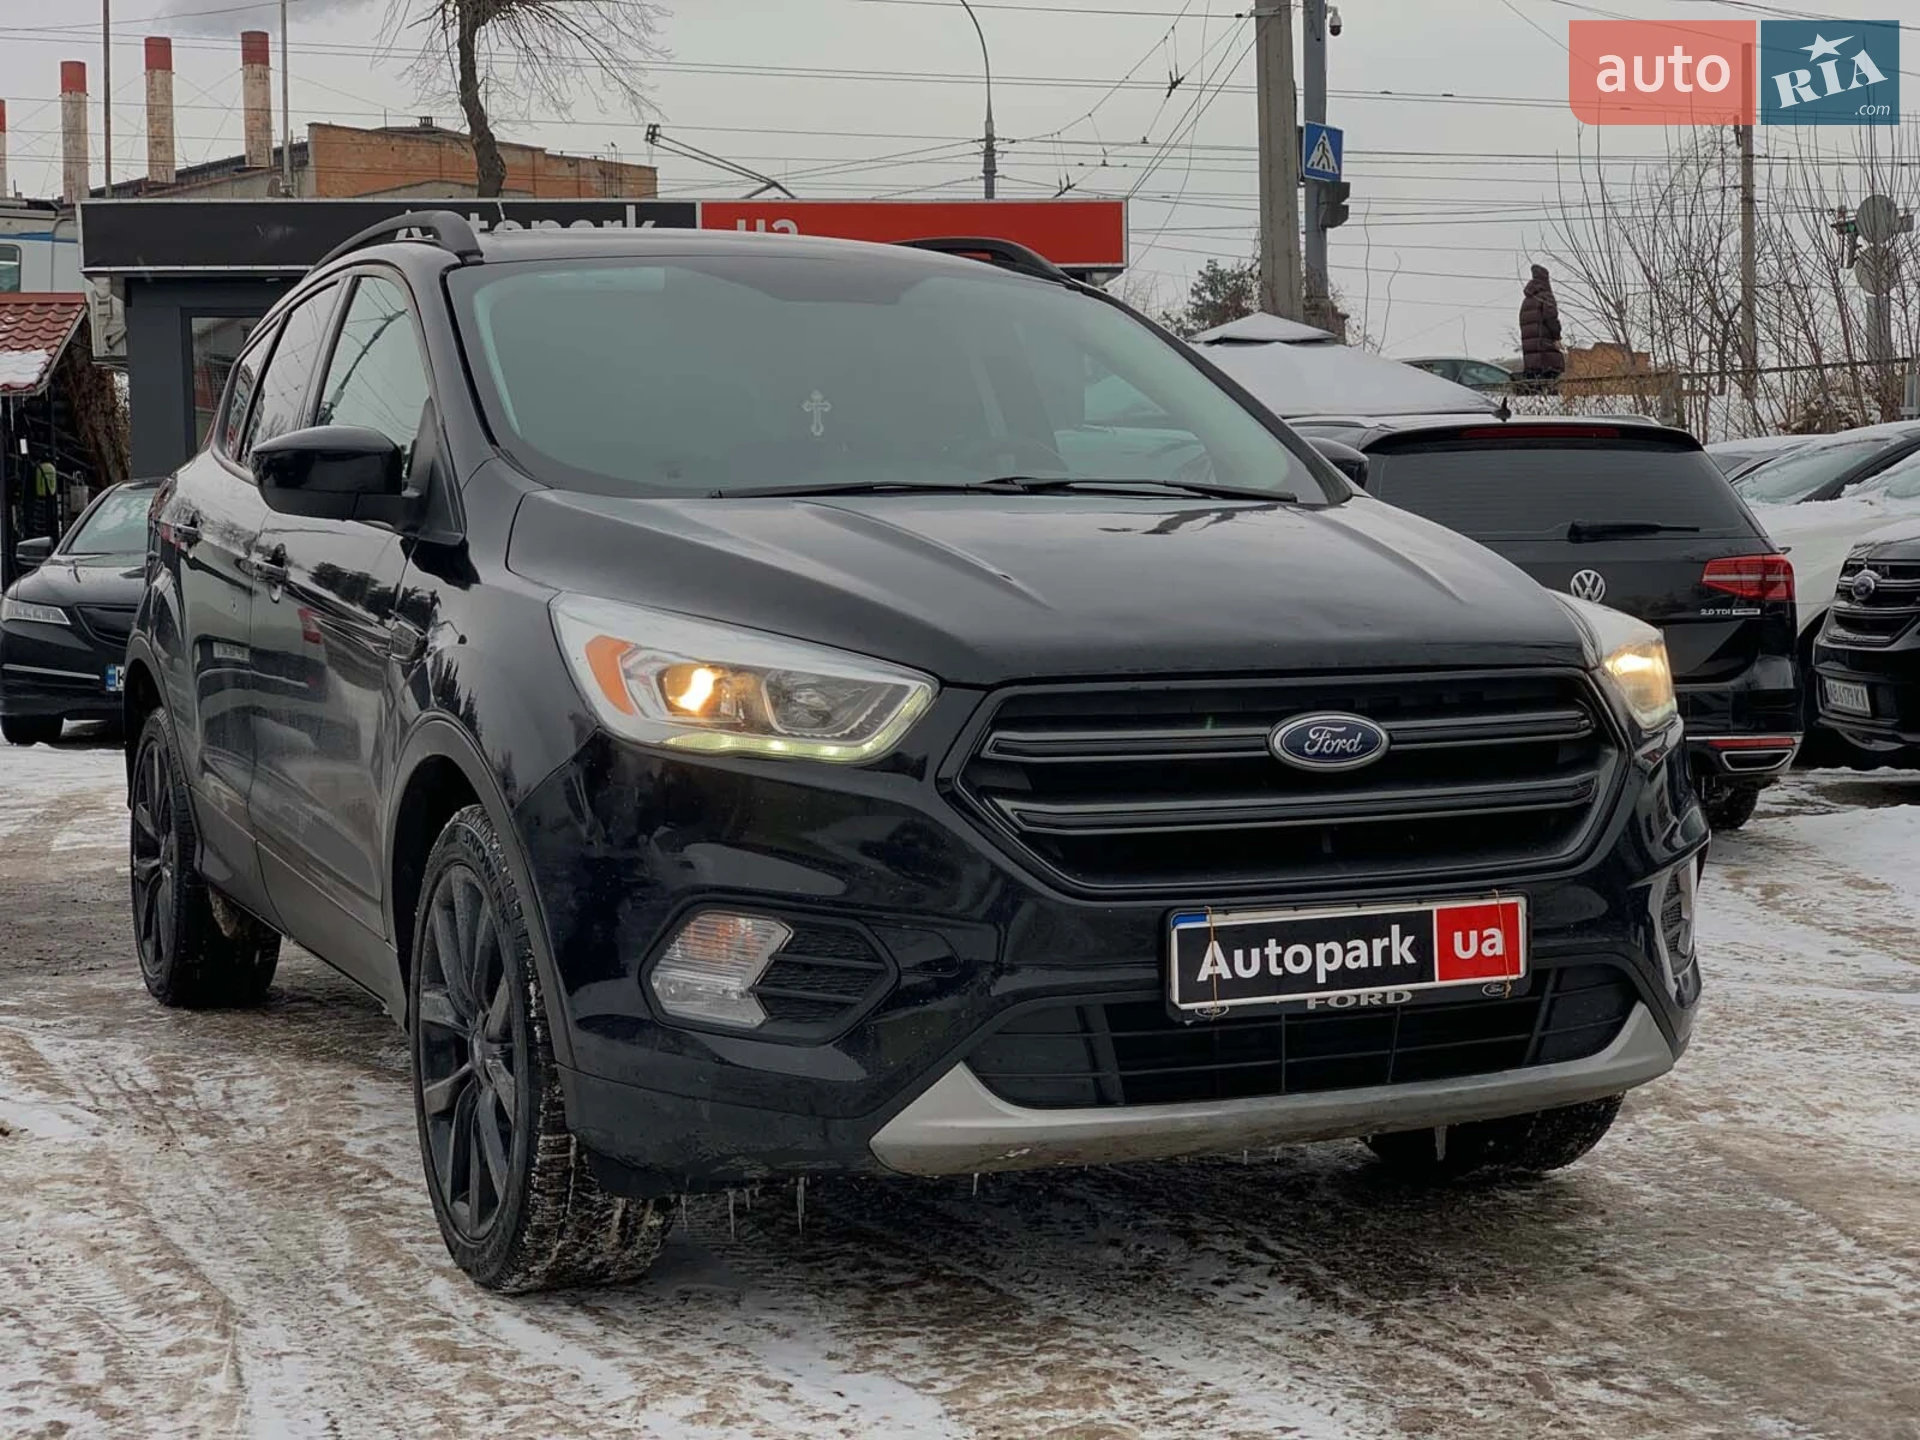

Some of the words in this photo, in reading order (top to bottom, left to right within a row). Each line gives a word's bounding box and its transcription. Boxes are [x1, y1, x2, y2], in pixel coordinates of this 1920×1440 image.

[1304, 726, 1362, 755] Ford
[1196, 924, 1417, 984] Autopark
[1453, 927, 1504, 960] ua
[1306, 990, 1412, 1010] FORD
